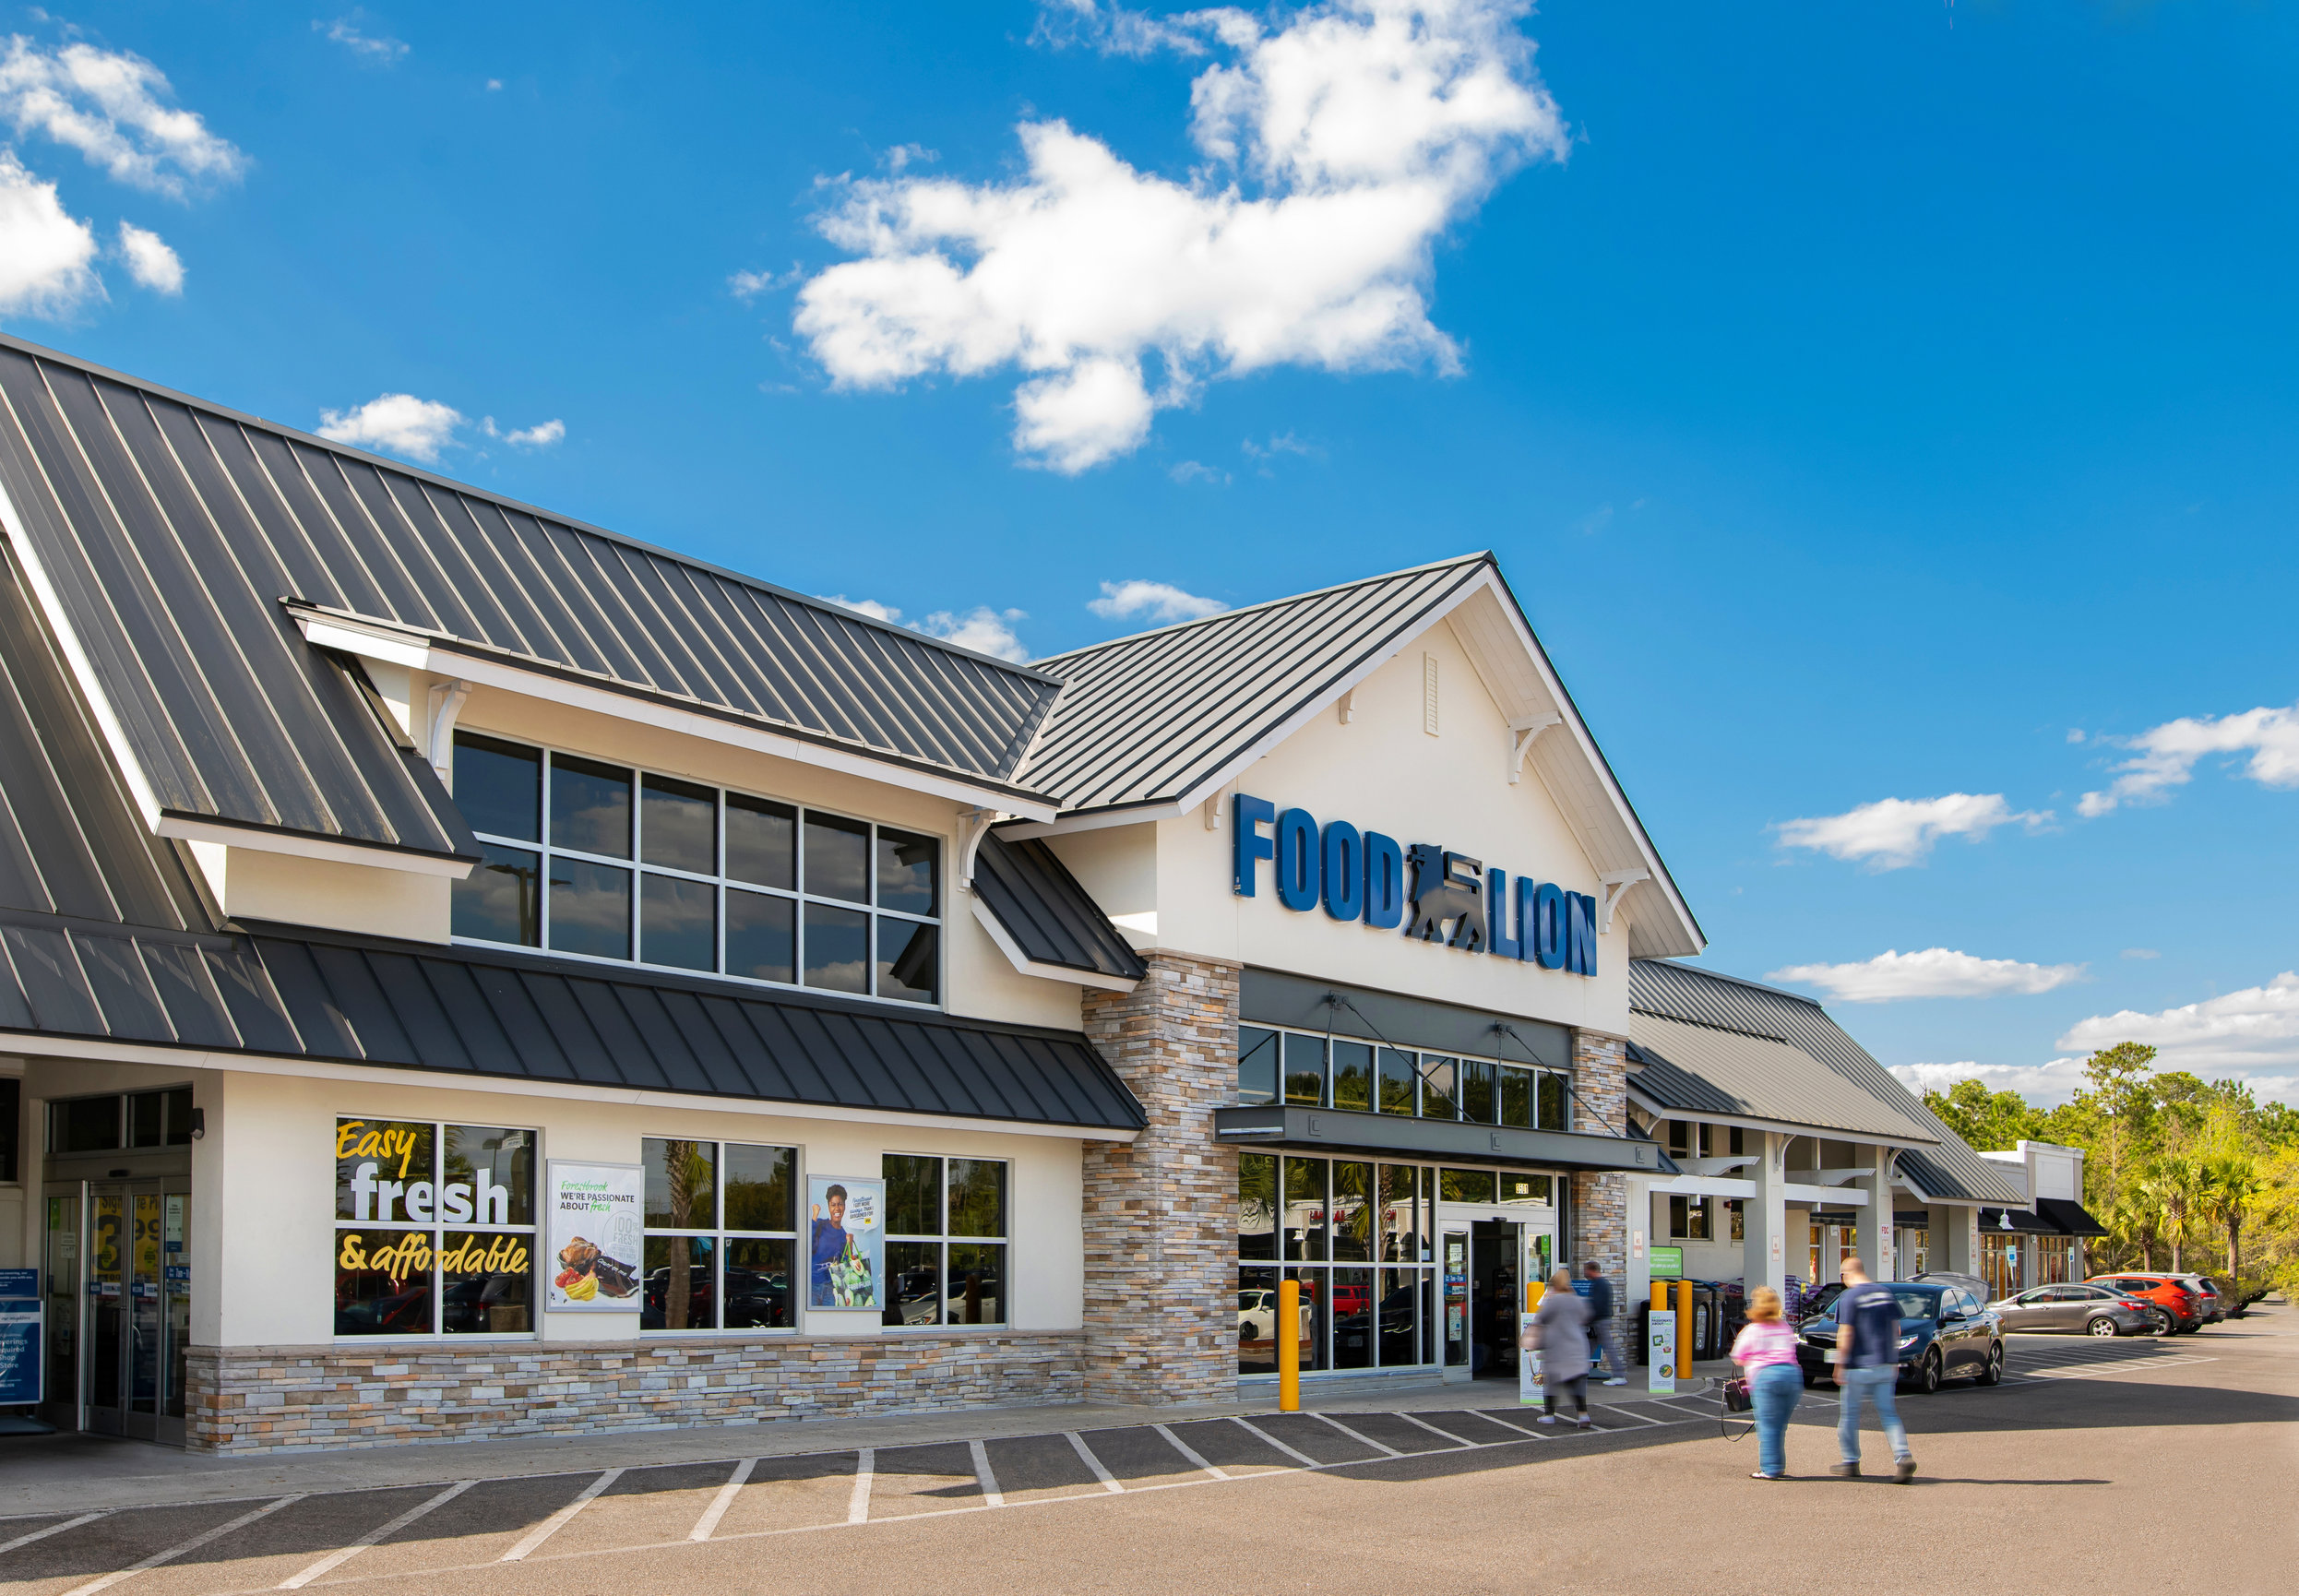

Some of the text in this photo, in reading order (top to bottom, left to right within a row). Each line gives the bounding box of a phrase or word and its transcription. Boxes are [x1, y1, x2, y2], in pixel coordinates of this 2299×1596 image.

[1233, 792, 1598, 977] FOOD LION
[336, 1121, 416, 1179] Easy
[351, 1161, 508, 1225] fresh
[560, 1192, 636, 1204] WE'RE PASSIONATE
[561, 1180, 608, 1192] Forestbrook
[560, 1200, 611, 1213] ABOUT fresh
[339, 1234, 369, 1270] &
[613, 1232, 638, 1247] FRESH
